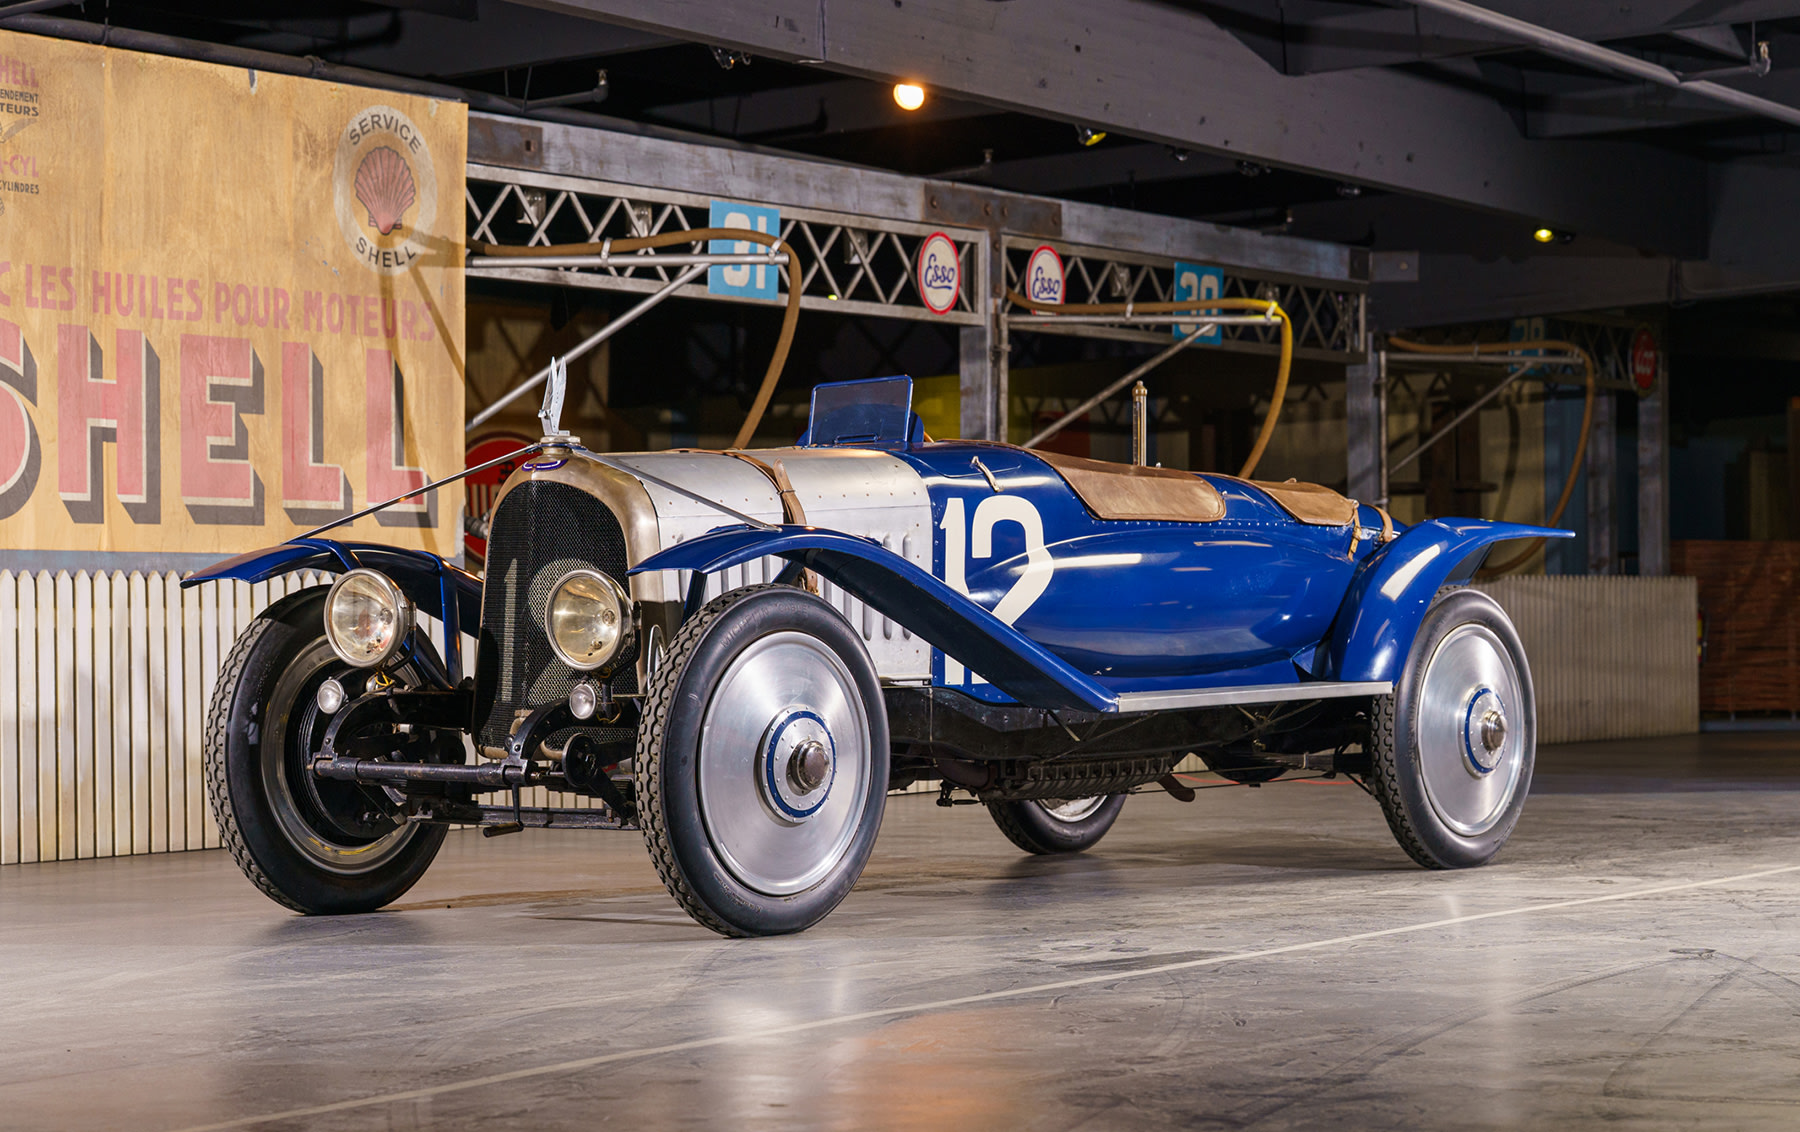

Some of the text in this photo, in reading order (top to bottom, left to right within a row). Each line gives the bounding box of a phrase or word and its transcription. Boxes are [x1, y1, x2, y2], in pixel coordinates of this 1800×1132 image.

[349, 114, 422, 154] SERVICE
[356, 237, 416, 268] SHELL
[723, 212, 767, 289] 31
[925, 253, 956, 291] Esso
[1032, 266, 1060, 302] Esso
[26, 264, 77, 311] LES
[92, 270, 203, 322] HUILES
[215, 282, 290, 330] POUR
[303, 290, 435, 342] MOTEURS
[940, 495, 1055, 685] 12
